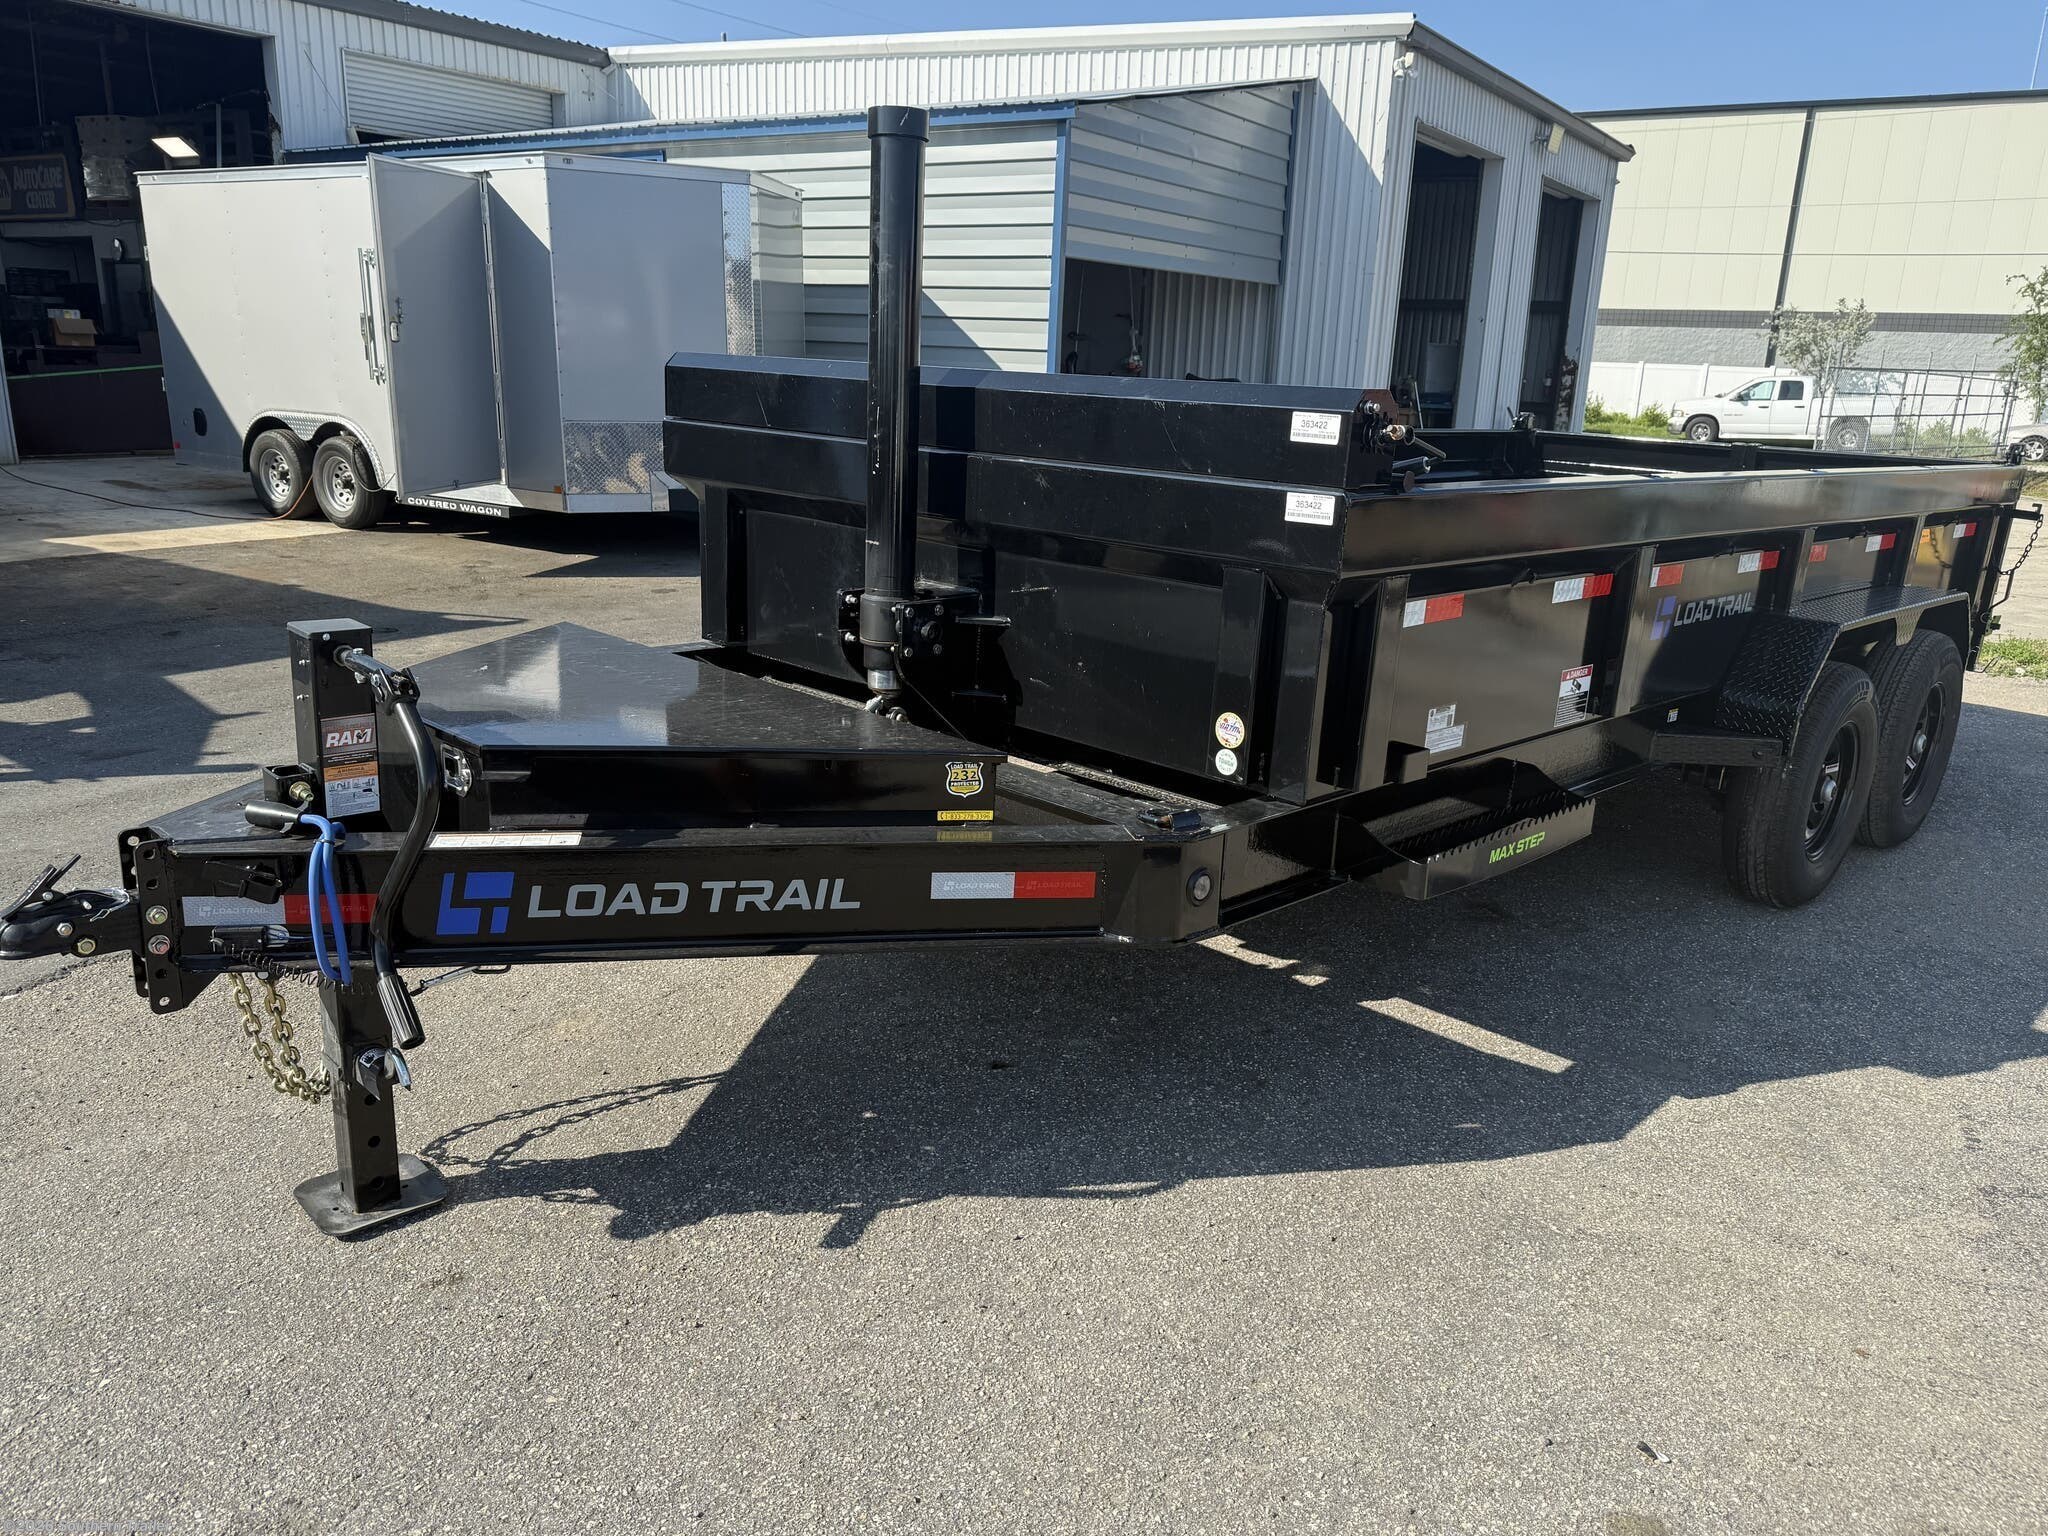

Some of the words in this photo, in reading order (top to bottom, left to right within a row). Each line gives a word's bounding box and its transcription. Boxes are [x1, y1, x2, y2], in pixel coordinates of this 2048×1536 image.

[26, 190, 56, 209] CENTER
[1300, 419, 1328, 430] 363422
[407, 497, 457, 511] COVERED
[460, 503, 502, 517] WAGON
[1295, 499, 1322, 510] 363422
[1673, 598, 1715, 627] LOAD
[1716, 592, 1753, 618] TRAIL
[326, 728, 372, 748] RAM
[1489, 842, 1516, 864] MAX
[1516, 832, 1546, 853] STEP
[527, 881, 689, 918] LOAD
[700, 878, 861, 913] TRAIL
[212, 907, 240, 915] LOAD
